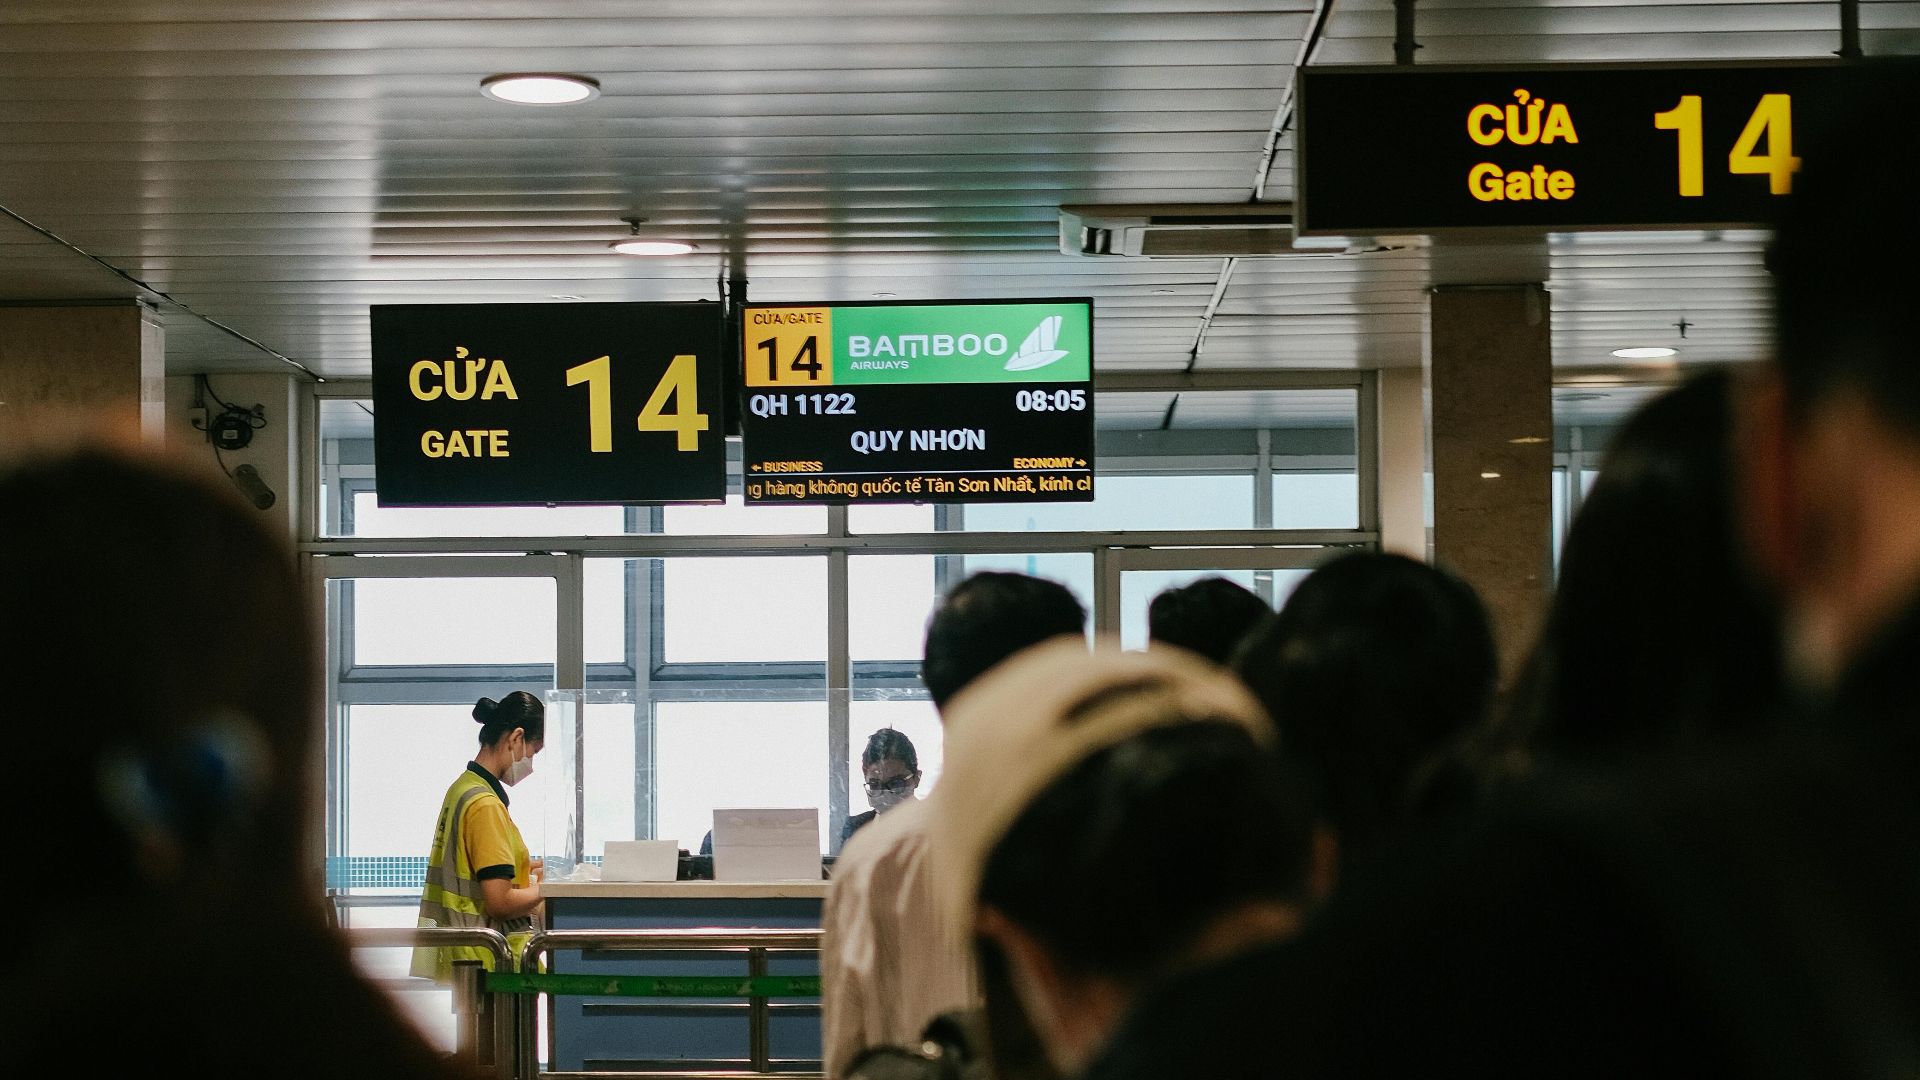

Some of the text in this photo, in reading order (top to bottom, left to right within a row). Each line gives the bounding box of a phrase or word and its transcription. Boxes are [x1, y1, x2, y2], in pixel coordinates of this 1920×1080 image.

[1467, 88, 1578, 146] CỬA
[1654, 94, 1802, 197] 14
[1468, 163, 1576, 201] Gate
[757, 335, 823, 381] 14
[848, 334, 1008, 359] BAMBOO
[409, 346, 519, 401] CỬA
[850, 361, 910, 370] AIRWAYS
[566, 355, 709, 453] 14
[749, 393, 857, 418] QH 1122
[1015, 389, 1087, 412] 08:05
[421, 430, 510, 458] GATE
[850, 428, 986, 454] QUY NHƠN
[762, 460, 824, 473] BUSINESS
[1013, 457, 1075, 469] ECONOMY
[765, 480, 806, 498] hàng
[808, 479, 859, 498] không
[861, 476, 901, 497] quốc
[904, 476, 923, 493] tế
[924, 477, 955, 493] Tân
[1039, 475, 1074, 491] kính
